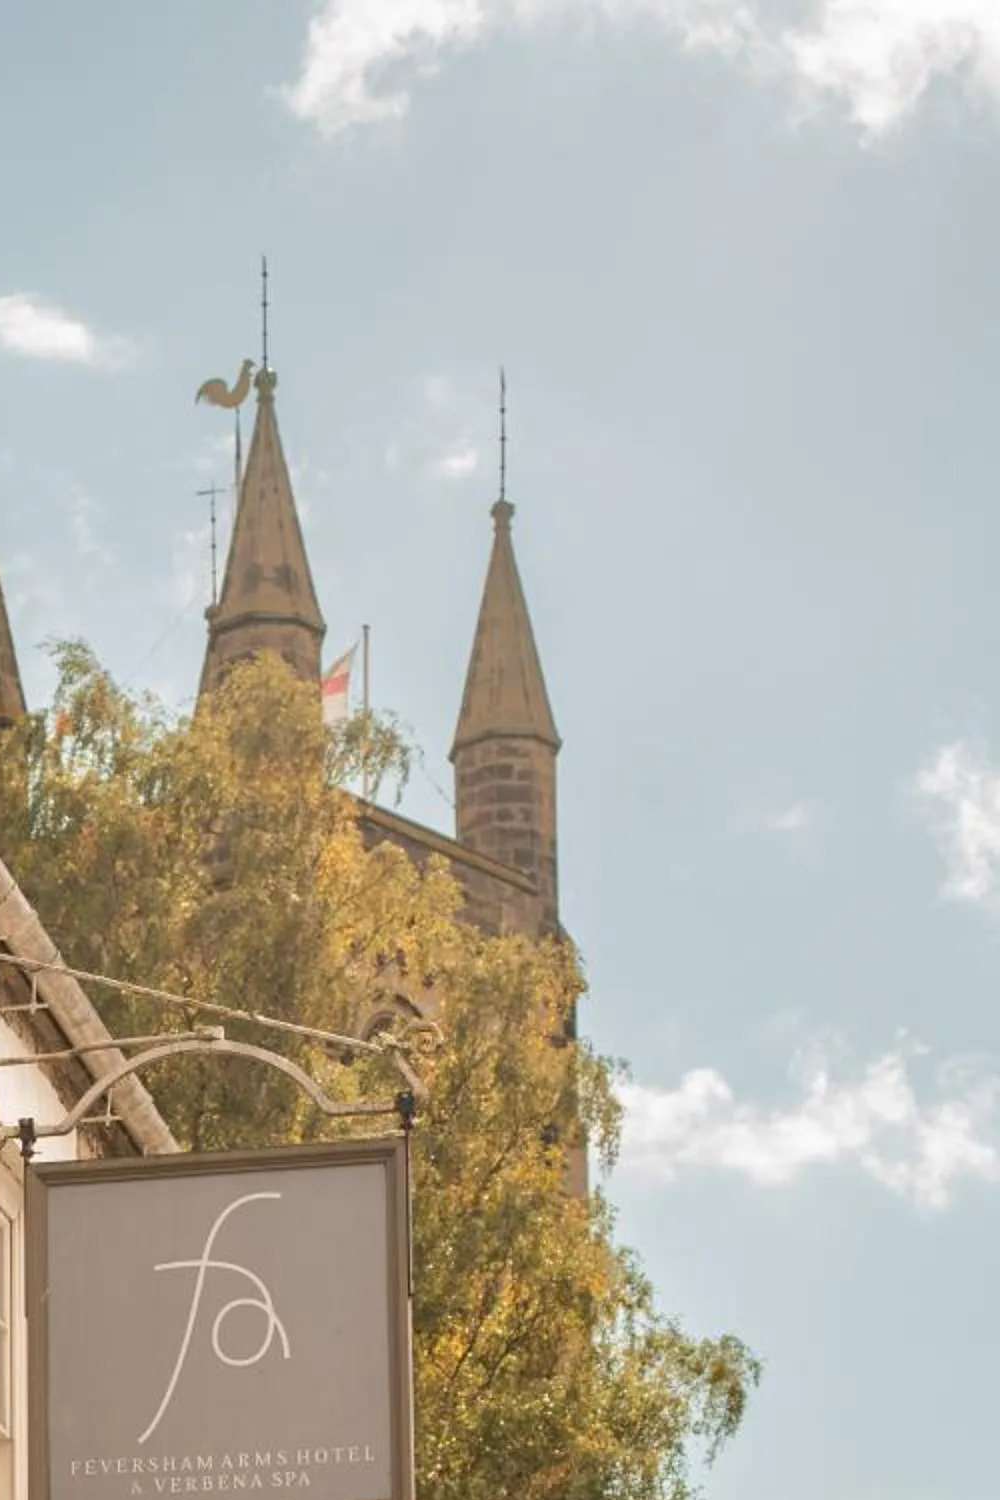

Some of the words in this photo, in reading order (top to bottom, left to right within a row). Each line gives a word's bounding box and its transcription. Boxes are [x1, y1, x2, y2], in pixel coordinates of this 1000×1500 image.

[70, 1455, 214, 1476] FEVERSHAM
[220, 1450, 288, 1469] ARMS
[296, 1444, 376, 1465] HOTEL
[153, 1473, 263, 1494] VERBENA
[271, 1470, 311, 1488] SPA
